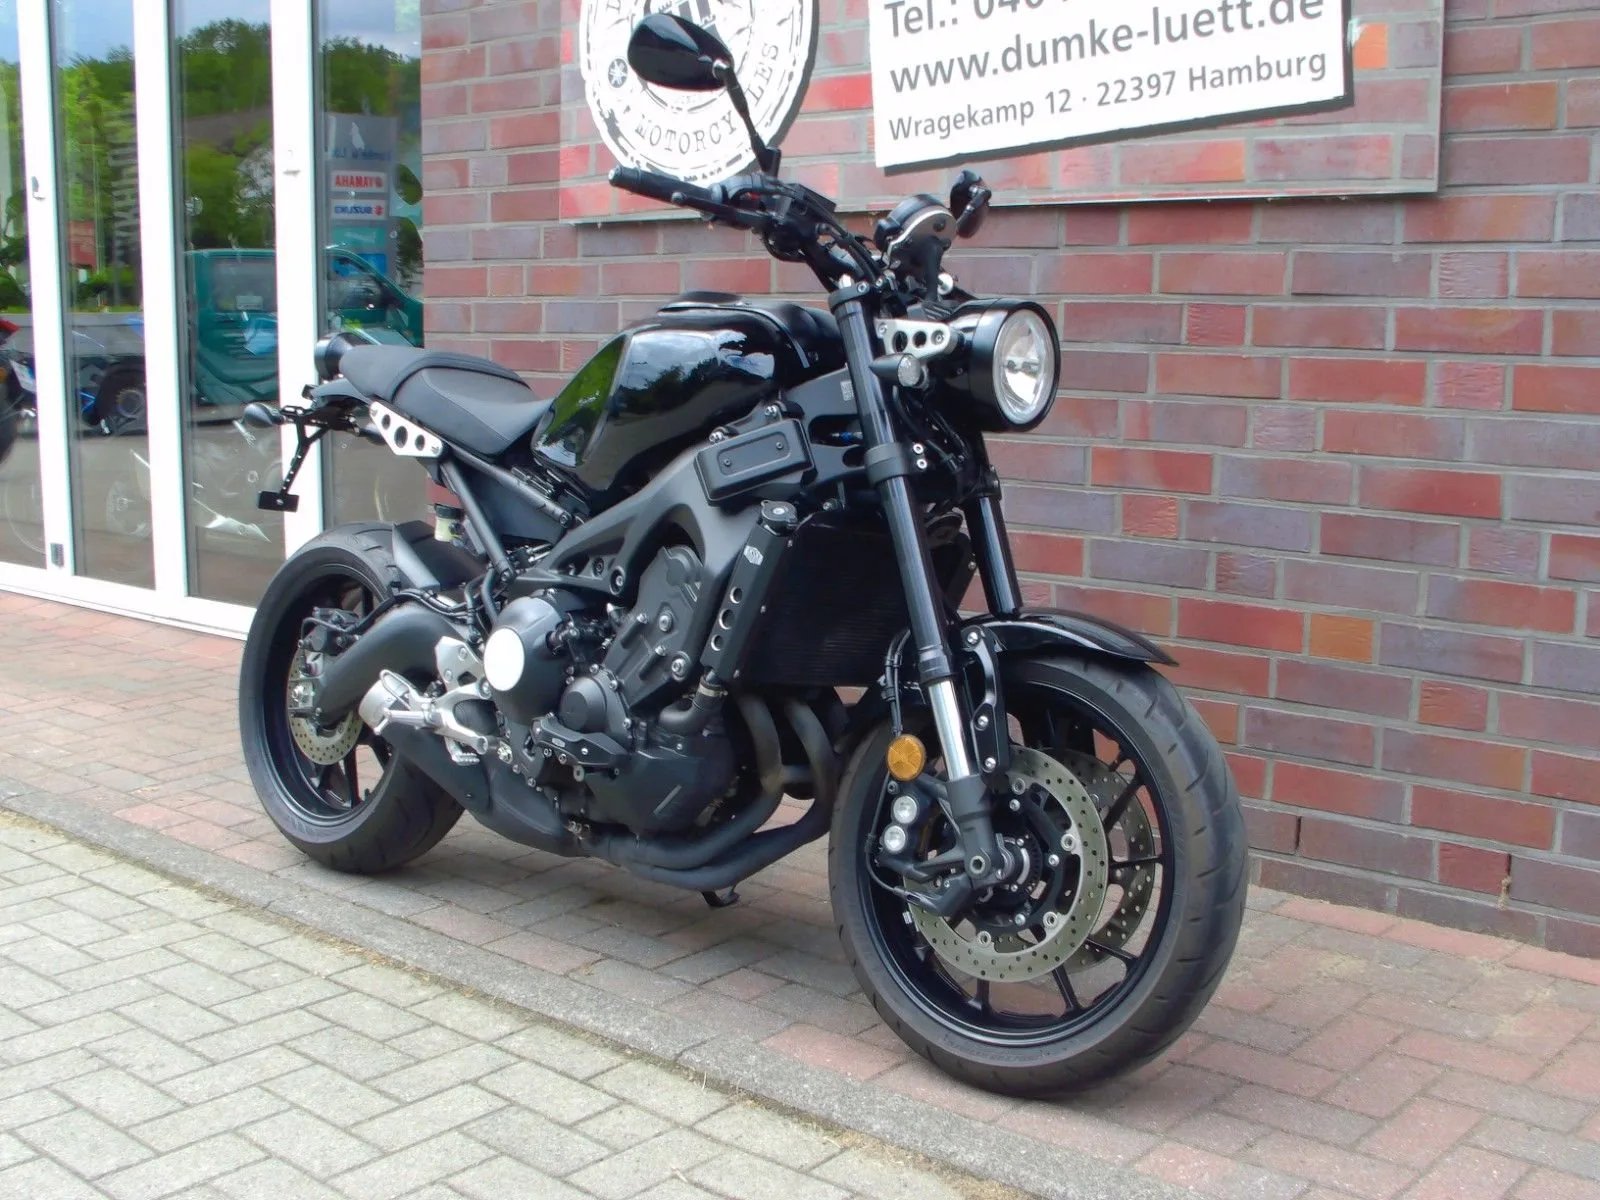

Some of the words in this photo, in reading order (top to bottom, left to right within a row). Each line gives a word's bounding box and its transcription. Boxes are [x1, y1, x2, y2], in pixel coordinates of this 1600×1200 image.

[884, 0, 958, 38] Tel.:
[889, 0, 1324, 94] www.dumke-luett.de
[634, 42, 780, 154] MOTORCYLES
[889, 100, 1035, 140] Wragekamp
[1045, 88, 1073, 115] 12
[1096, 70, 1177, 107] 22397
[1188, 53, 1327, 92] Hamburg
